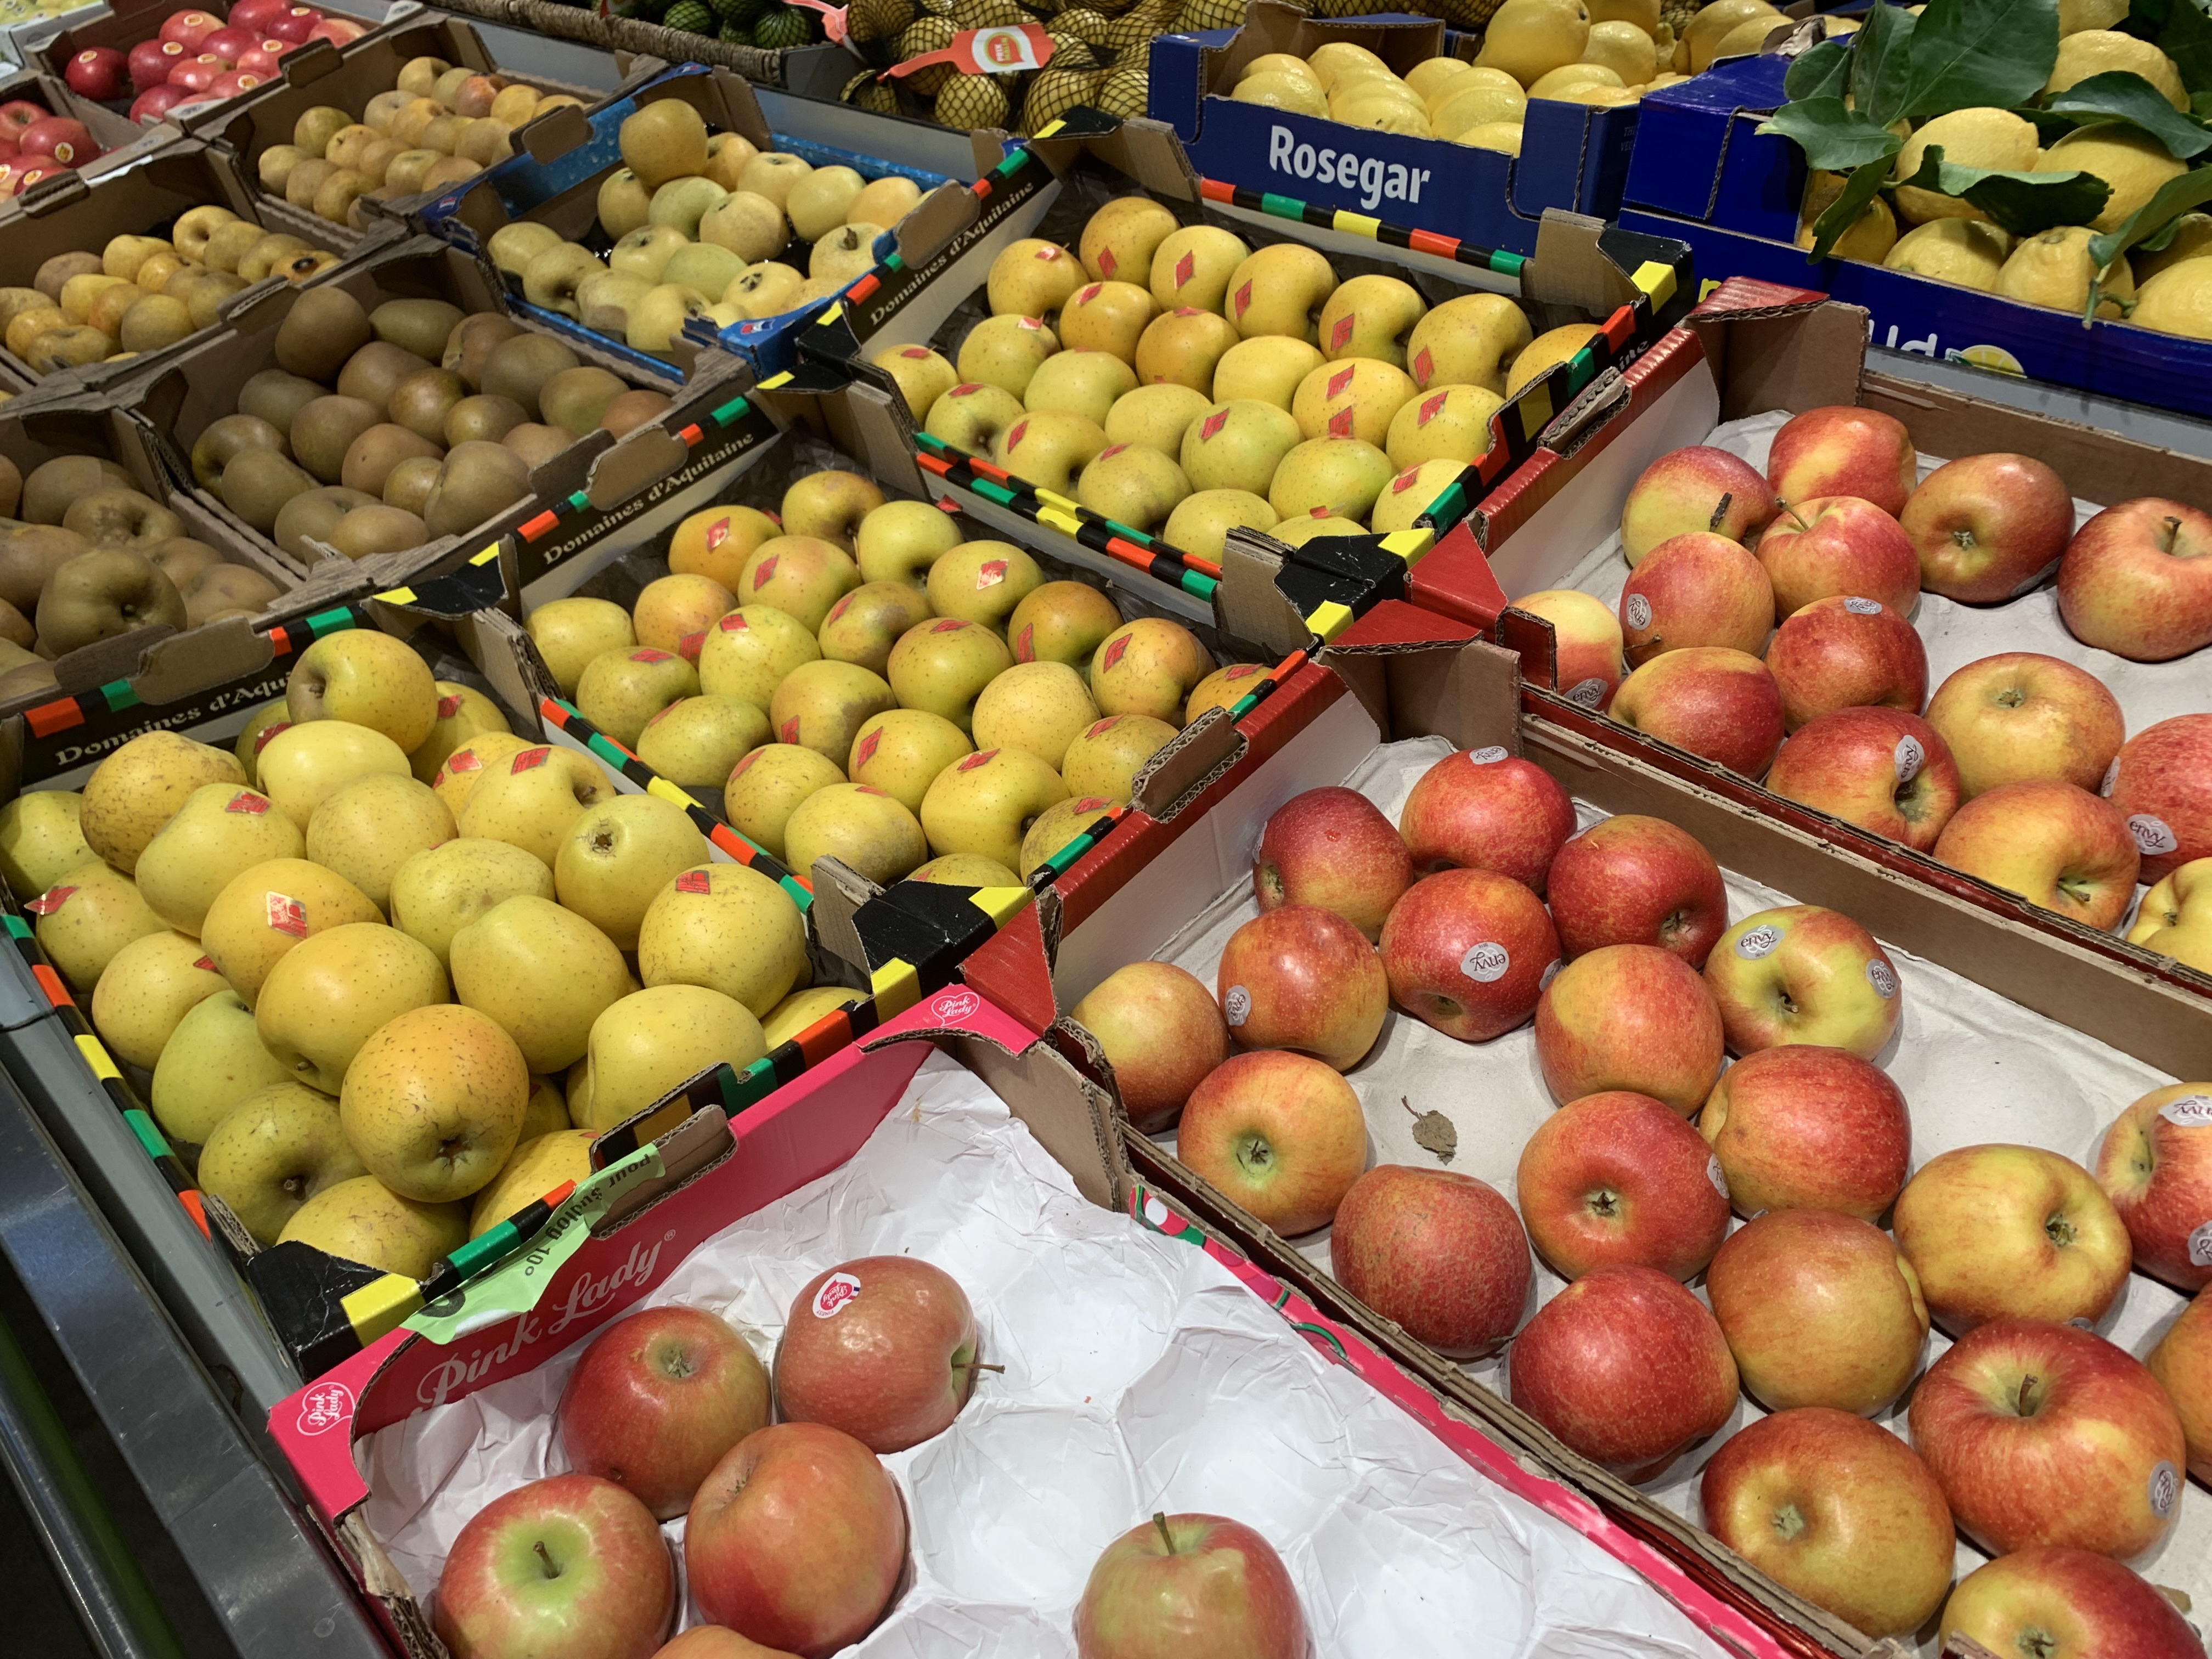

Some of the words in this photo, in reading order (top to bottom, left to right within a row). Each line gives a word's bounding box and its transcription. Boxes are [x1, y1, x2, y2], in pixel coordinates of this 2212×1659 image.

[1269, 125, 1431, 210] Rosegar
[870, 253, 947, 326] Domaines
[950, 182, 1034, 256] d'Aquitaine
[543, 498, 645, 565] Domaines
[648, 433, 754, 501] d'Aquitaine
[1629, 597, 1645, 625] envy
[1572, 685, 1603, 702] envy
[55, 706, 201, 766] Domaines
[1476, 747, 1502, 760] envy
[1901, 744, 1918, 778] envy
[2130, 821, 2165, 848] envy
[1741, 930, 1777, 949] envy
[1470, 952, 1506, 972] envy
[1871, 969, 1895, 990] envy
[939, 995, 970, 1011] Pink
[2173, 1100, 2212, 1115] nvy
[608, 1154, 651, 1188] pour
[545, 1187, 603, 1240] Sudlog
[827, 1285, 848, 1307] Pink
[411, 1312, 542, 1414] Pink
[308, 1392, 327, 1426] Pink
